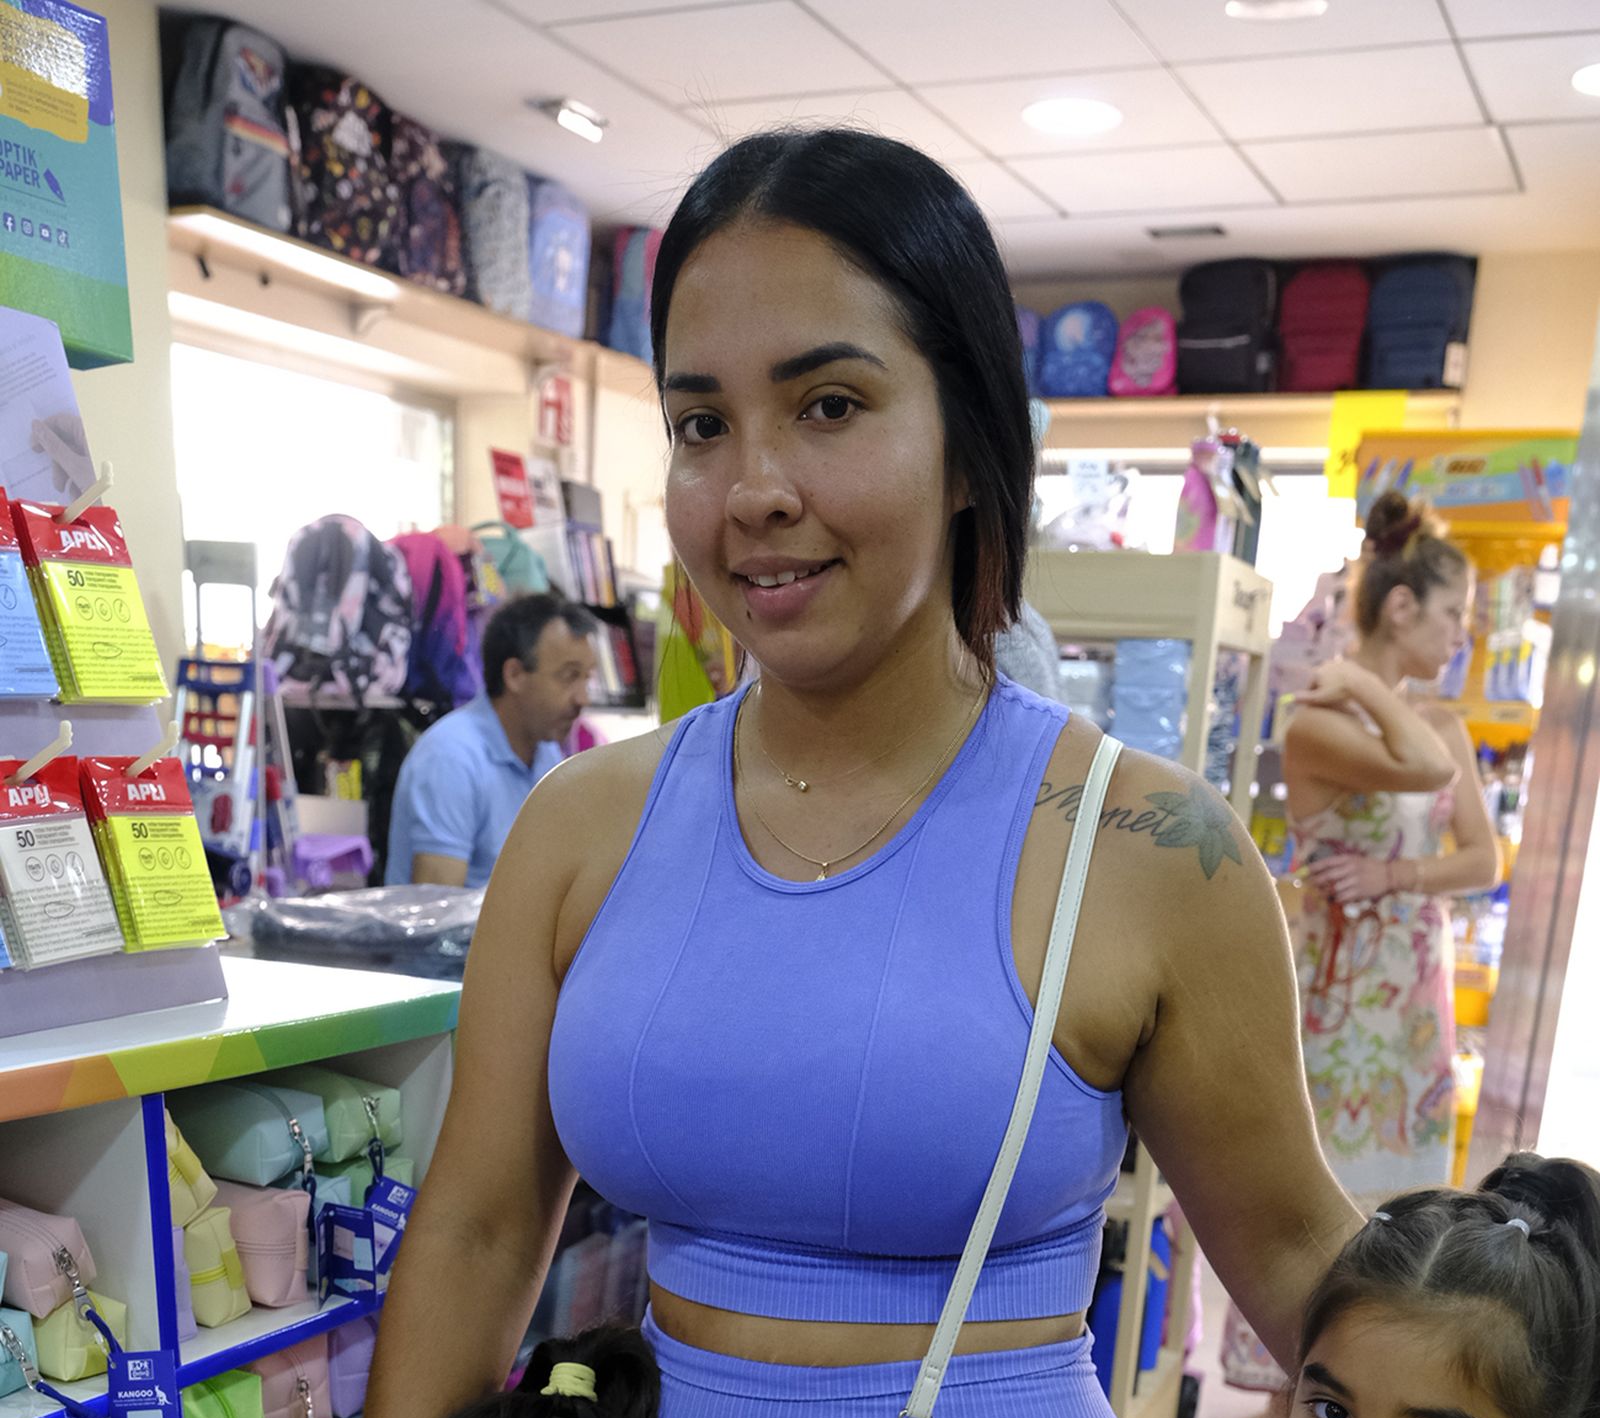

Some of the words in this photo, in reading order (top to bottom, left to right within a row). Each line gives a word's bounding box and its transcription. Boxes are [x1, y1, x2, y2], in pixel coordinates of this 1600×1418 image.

[66, 569, 85, 588] 50
[126, 783, 166, 801] APLI
[16, 829, 36, 848] 50
[131, 822, 149, 839] 50
[117, 1389, 154, 1399] KANGOO
